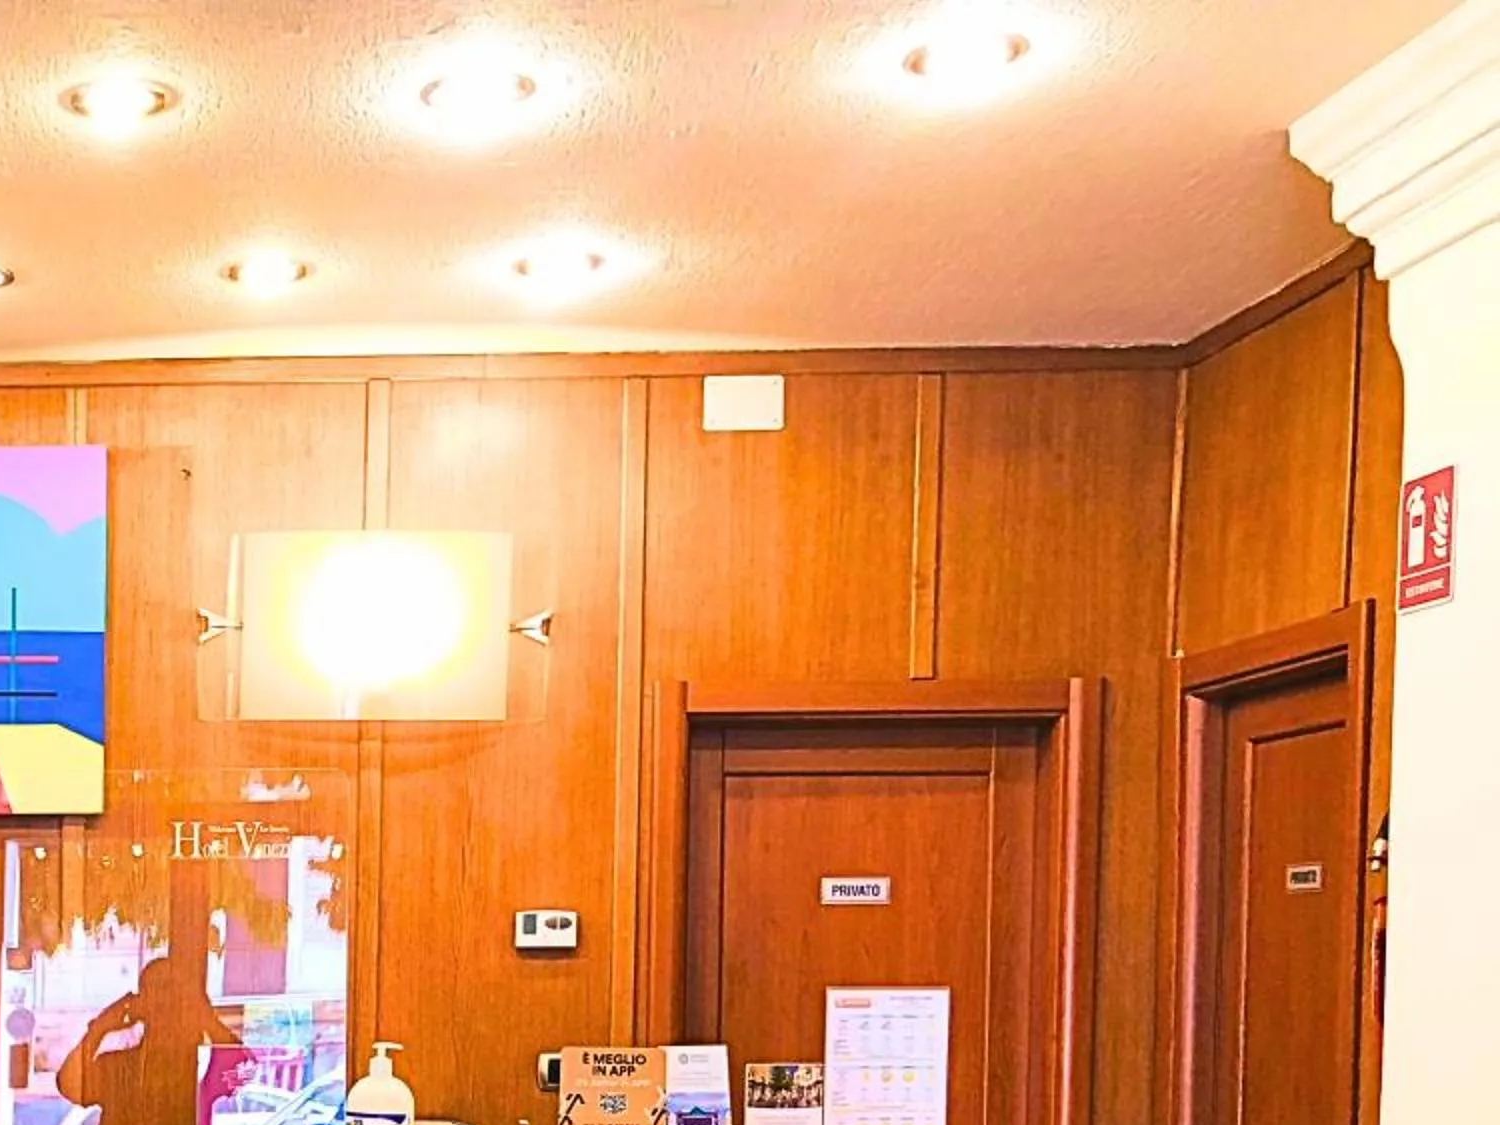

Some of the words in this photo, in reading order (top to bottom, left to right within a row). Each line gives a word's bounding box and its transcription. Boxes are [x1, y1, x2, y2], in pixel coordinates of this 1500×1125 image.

[831, 884, 881, 897] PRIVATO
[582, 1051, 590, 1065] È
[593, 1053, 647, 1065] MEGLIO
[592, 1065, 606, 1076] IN
[609, 1065, 636, 1077] APP
